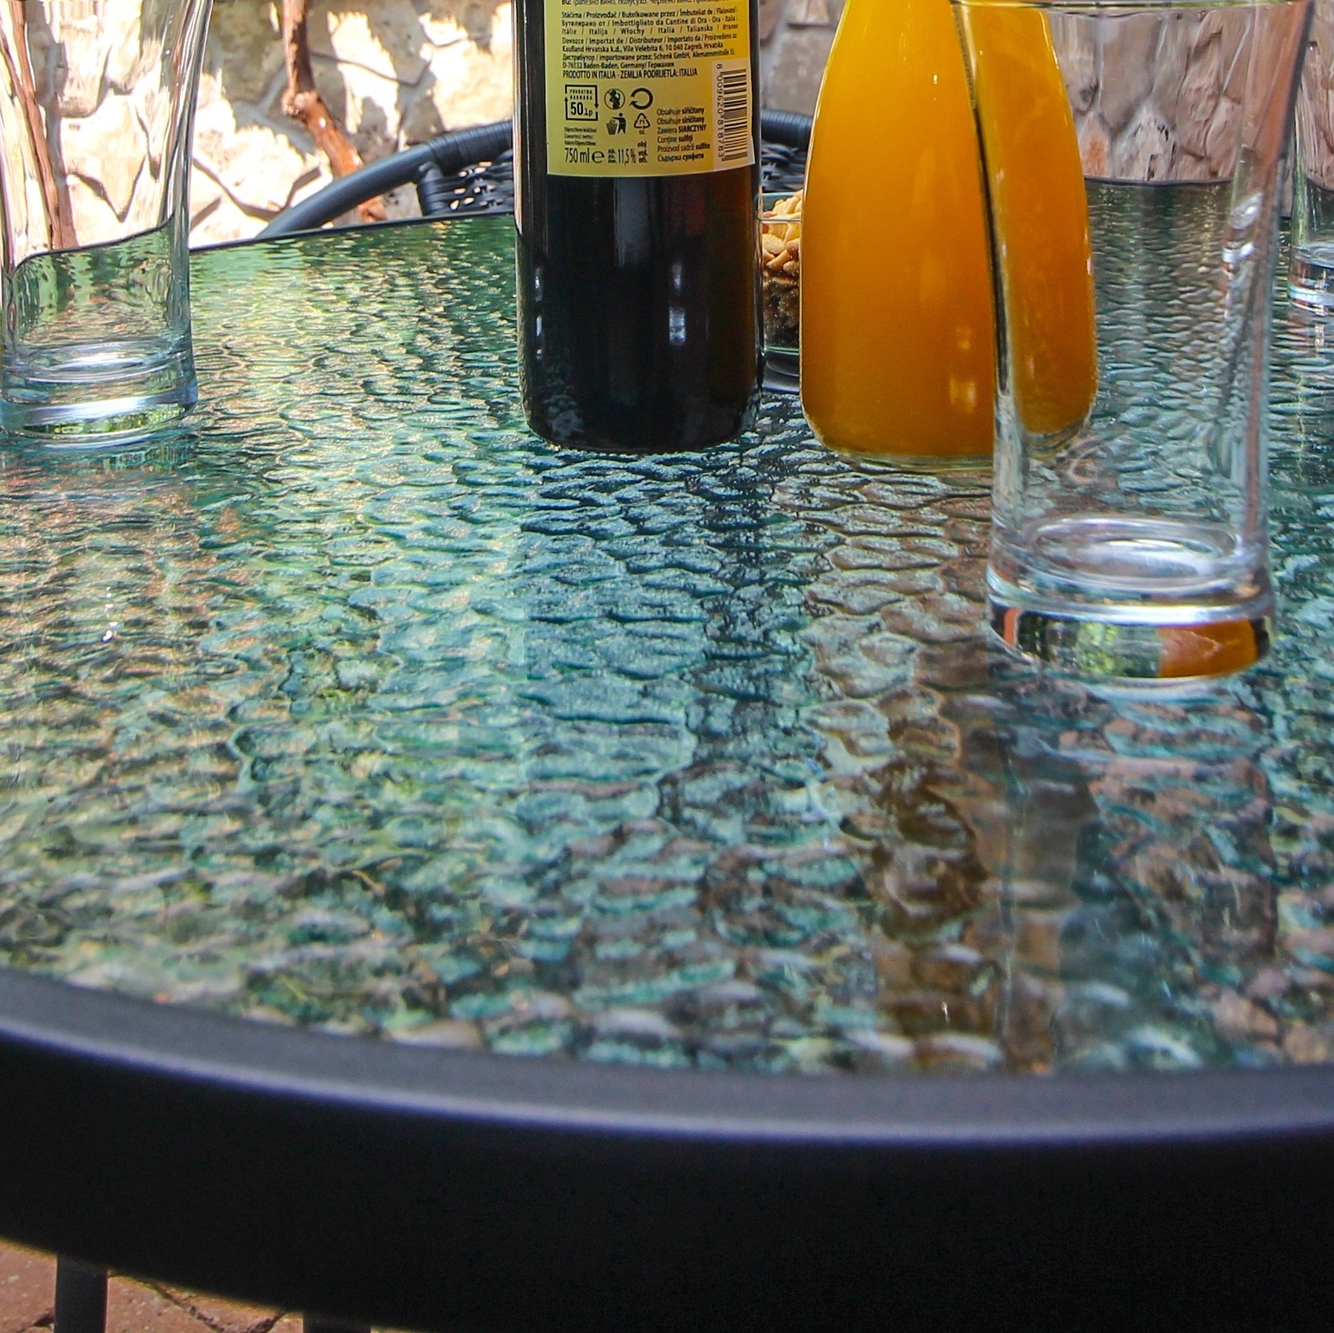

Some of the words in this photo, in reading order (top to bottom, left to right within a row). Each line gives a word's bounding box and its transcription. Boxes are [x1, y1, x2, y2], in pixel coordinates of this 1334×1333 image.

[563, 70, 590, 79] PRODOTTO
[620, 70, 642, 78] ZEMLJA
[565, 148, 578, 163] 750
[580, 148, 589, 163] ml
